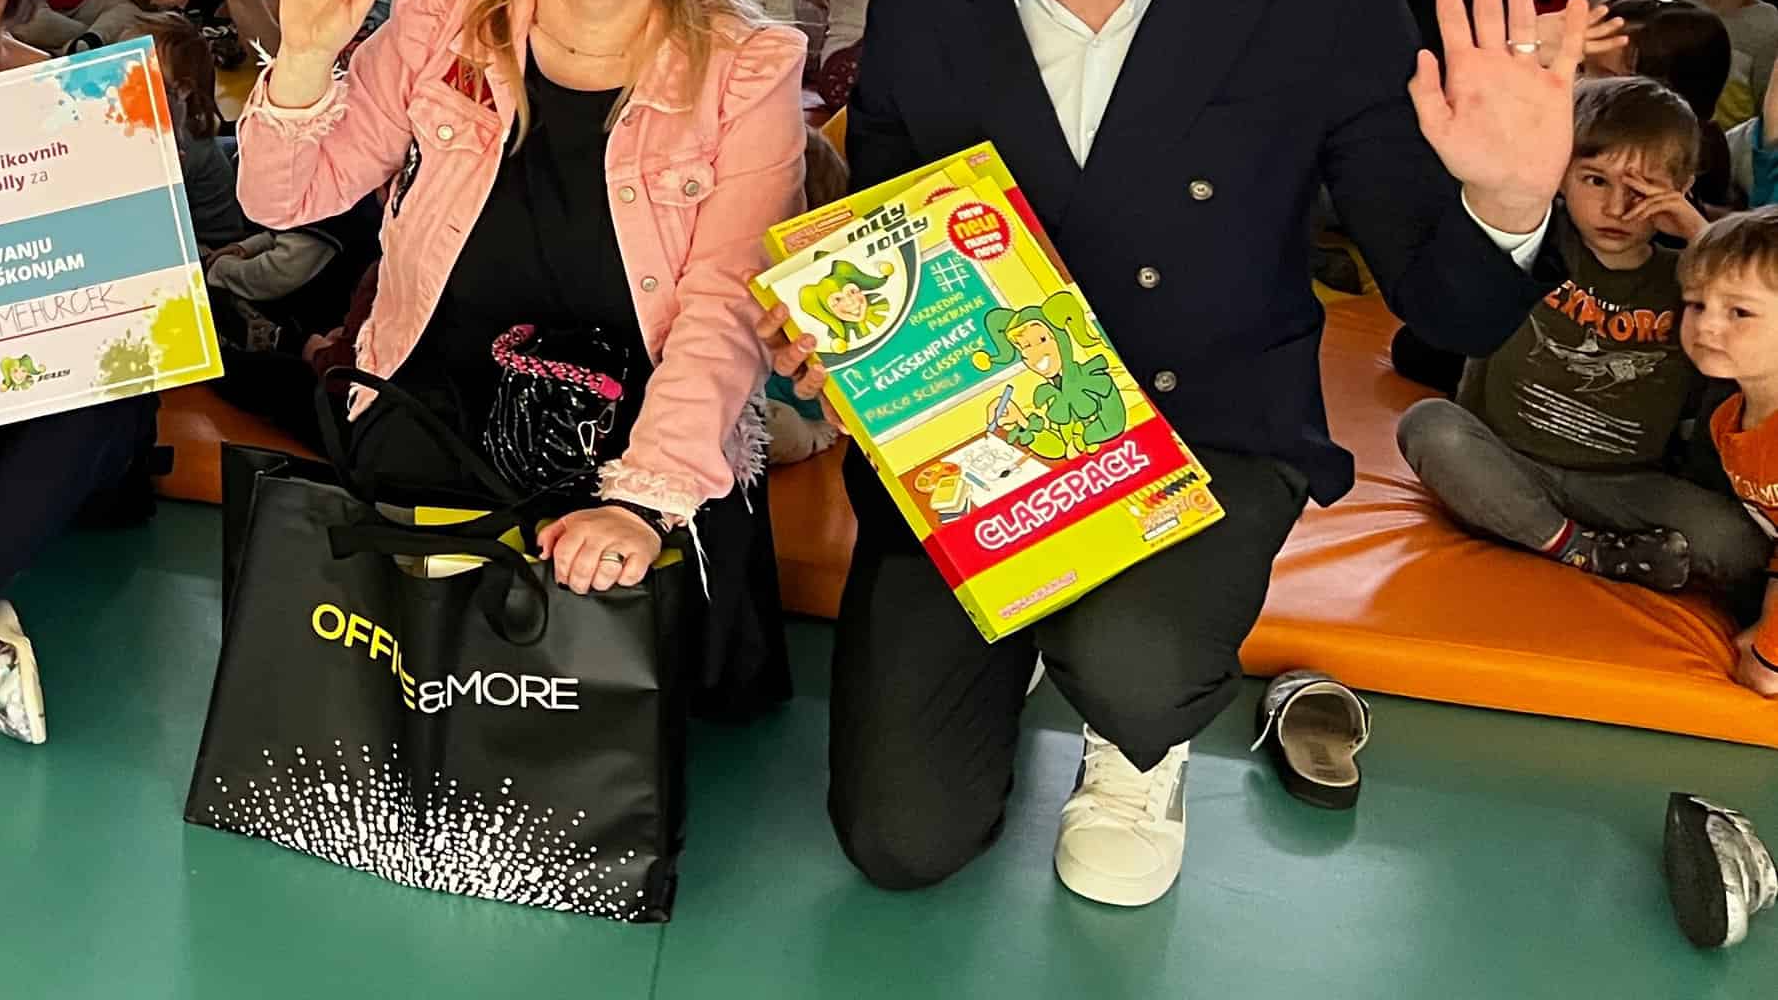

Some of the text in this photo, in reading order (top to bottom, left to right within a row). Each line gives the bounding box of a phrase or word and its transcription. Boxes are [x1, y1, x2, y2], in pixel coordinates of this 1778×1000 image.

[30, 169, 49, 185] za
[866, 217, 929, 257] JOLLY
[874, 319, 977, 391] KLASSENPAKET
[922, 336, 985, 381] CLASSPACK
[975, 441, 1150, 550] CLASSPACK
[311, 603, 580, 714] OFFIE&MORE
